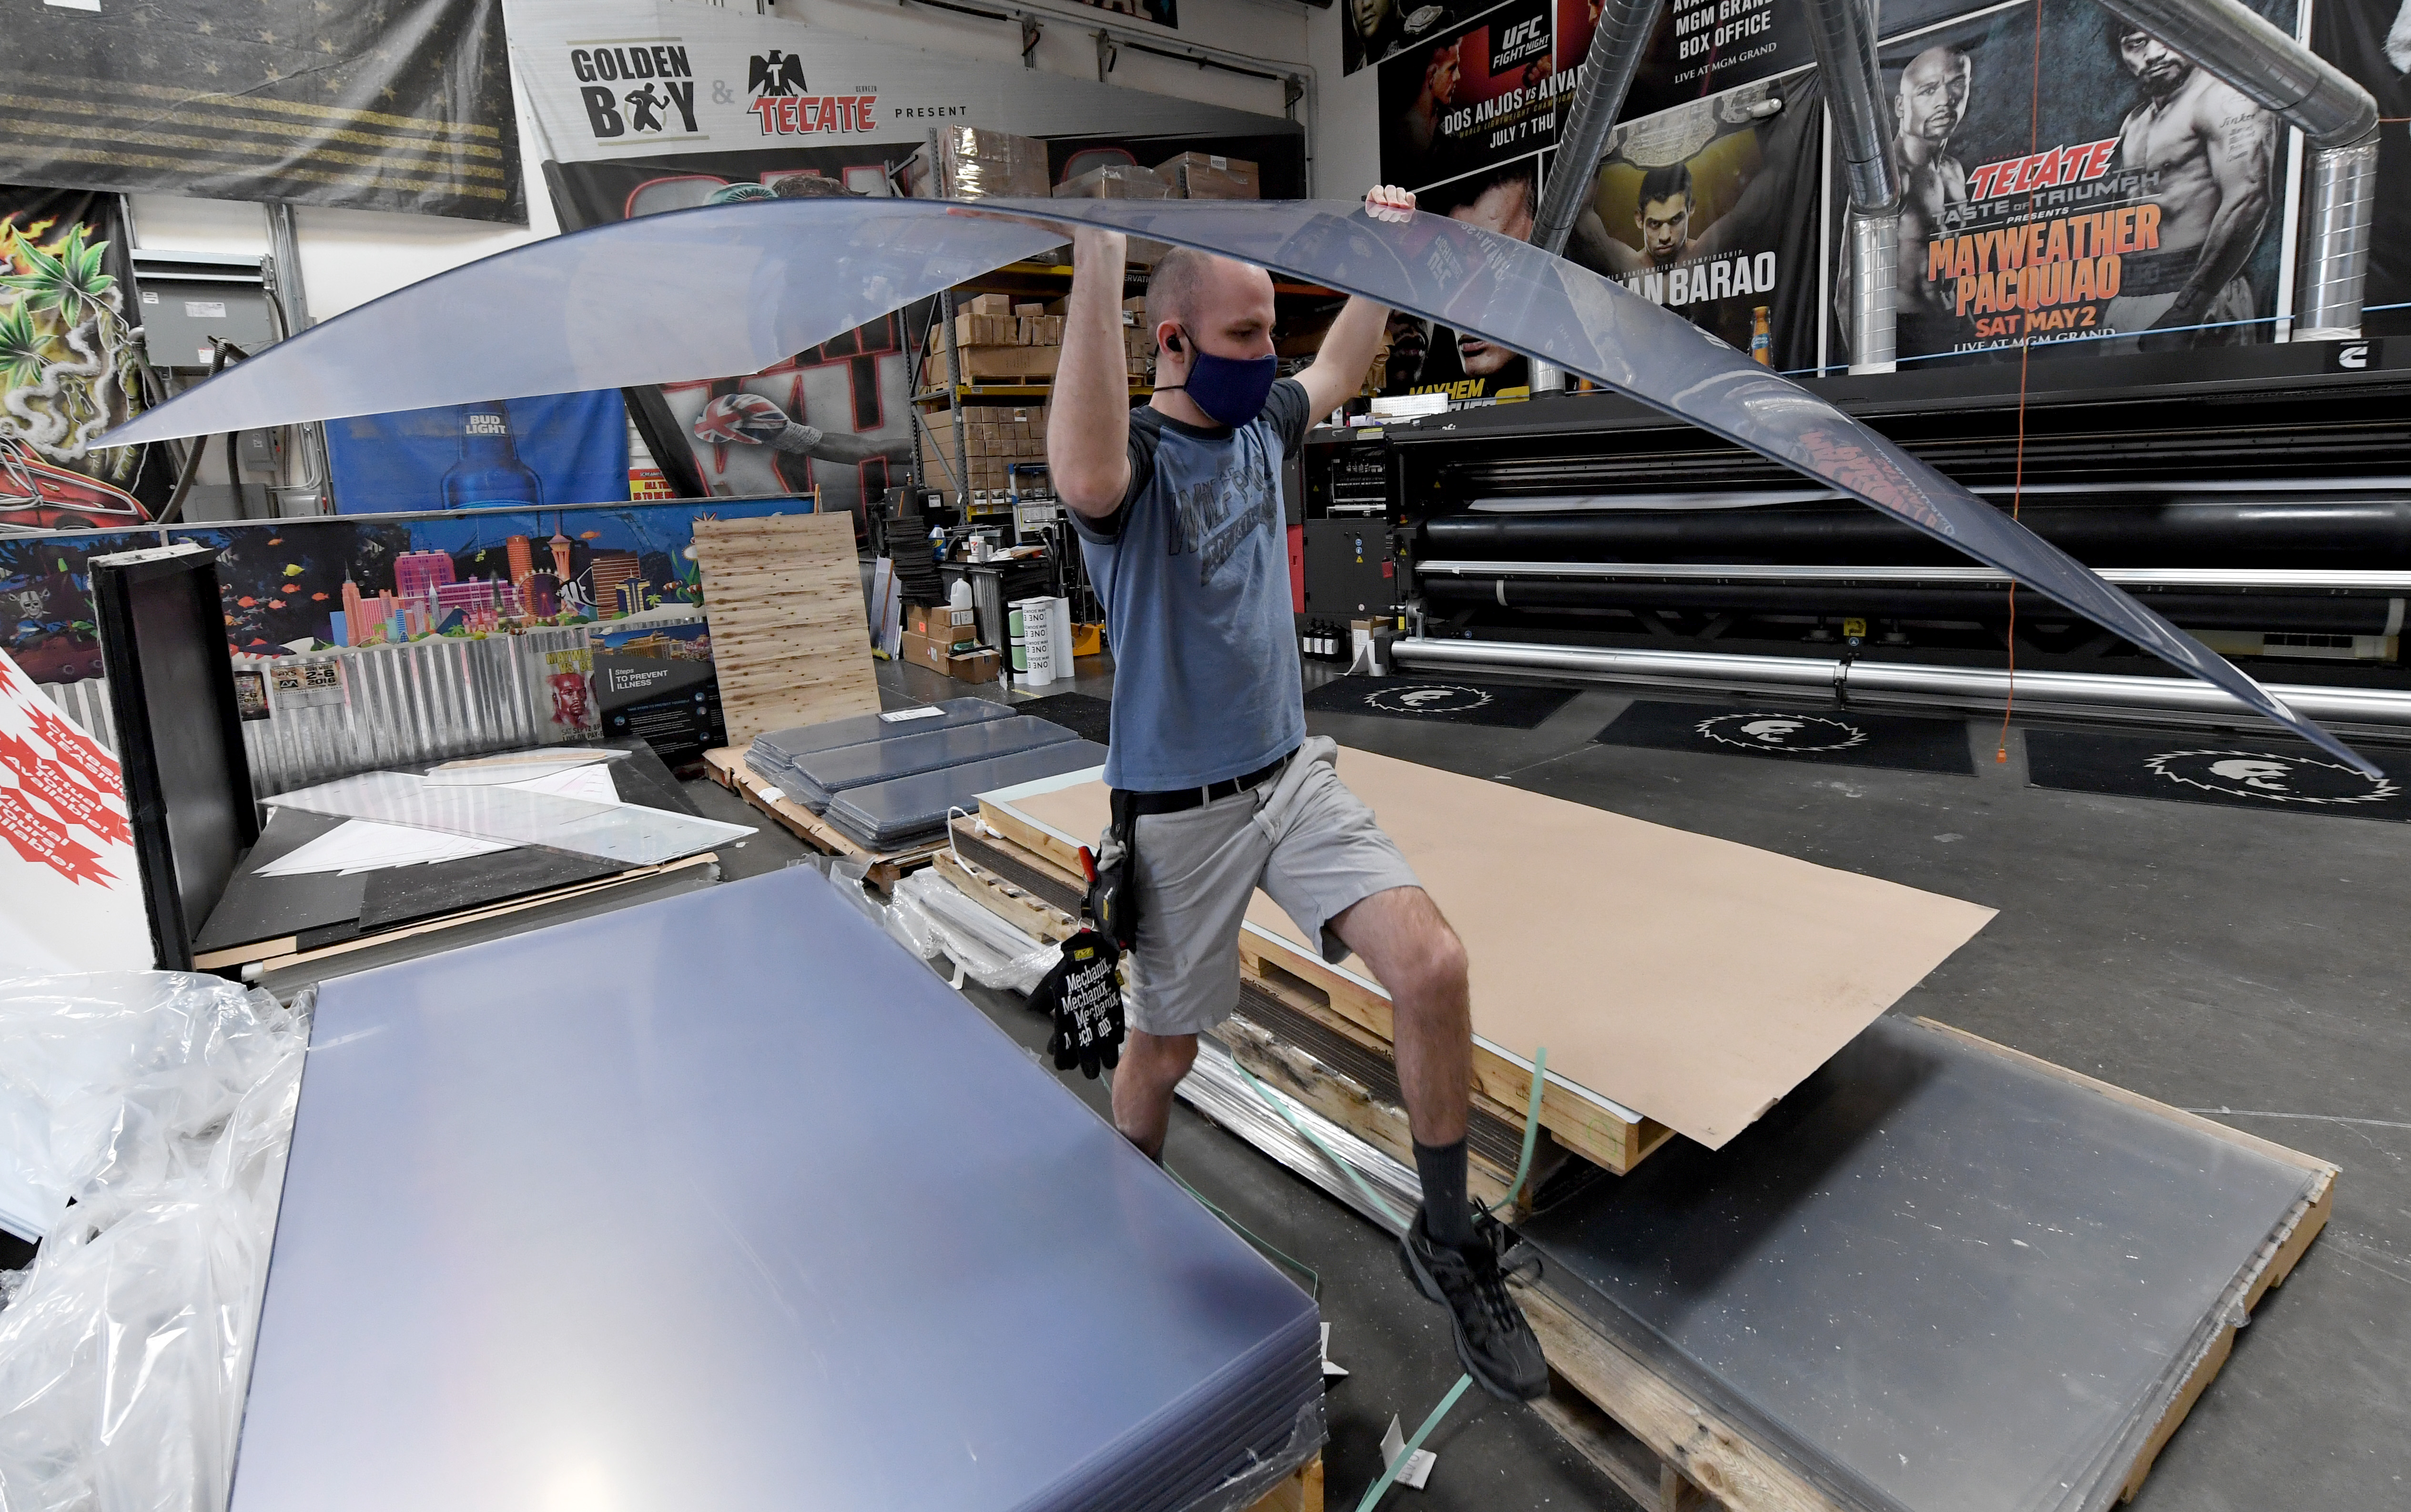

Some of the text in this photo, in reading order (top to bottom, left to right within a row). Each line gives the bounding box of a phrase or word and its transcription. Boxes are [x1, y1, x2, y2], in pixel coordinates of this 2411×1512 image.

[1502, 14, 1543, 50] UFC
[1676, 5, 1714, 37] MGM
[1720, 0, 1773, 20] GRA
[1680, 10, 1771, 60] BOX OFFICE
[570, 46, 692, 82] GOLDEN
[1493, 34, 1550, 69] FIGHT NIGHT
[1675, 42, 1777, 84] LIVE AT MGM GRAND
[712, 80, 735, 104] &
[747, 95, 878, 135] TECATE
[895, 106, 966, 118] PRESENT
[1444, 108, 1471, 135] DOS
[1475, 88, 1523, 124] ANJOS
[1525, 87, 1537, 101] VS
[1489, 112, 1554, 149] JULY 7 THU
[1966, 136, 2122, 202] TECATE
[1933, 199, 2010, 226] TASTE
[2032, 171, 2160, 207] TRIUMPH
[2006, 207, 2069, 224] PRESENTS
[1928, 203, 2162, 281] MAYWEATHER
[1623, 262, 1678, 279] BANTAMWEIGHT
[1682, 249, 1743, 267] CHAMPIONSHIP
[1669, 251, 1776, 306] BARAO
[1956, 254, 2121, 316] PACQUIAO
[1954, 328, 2116, 353] LIVE AT MGM GRAND
[1975, 315, 2021, 337] SAT
[466, 424, 506, 434] LIGHT
[470, 415, 500, 425] BUD
[1029, 613, 1044, 621] ONE
[305, 670, 334, 679] 2-6
[630, 670, 668, 680] PREVENT
[1033, 661, 1048, 669] ONE
[617, 679, 652, 690] ILLNESS
[37, 757, 103, 812] Virtual
[1065, 957, 1110, 994] Mechanix
[1061, 980, 1109, 1015] Mechanix
[1074, 992, 1119, 1029] Mechanix
